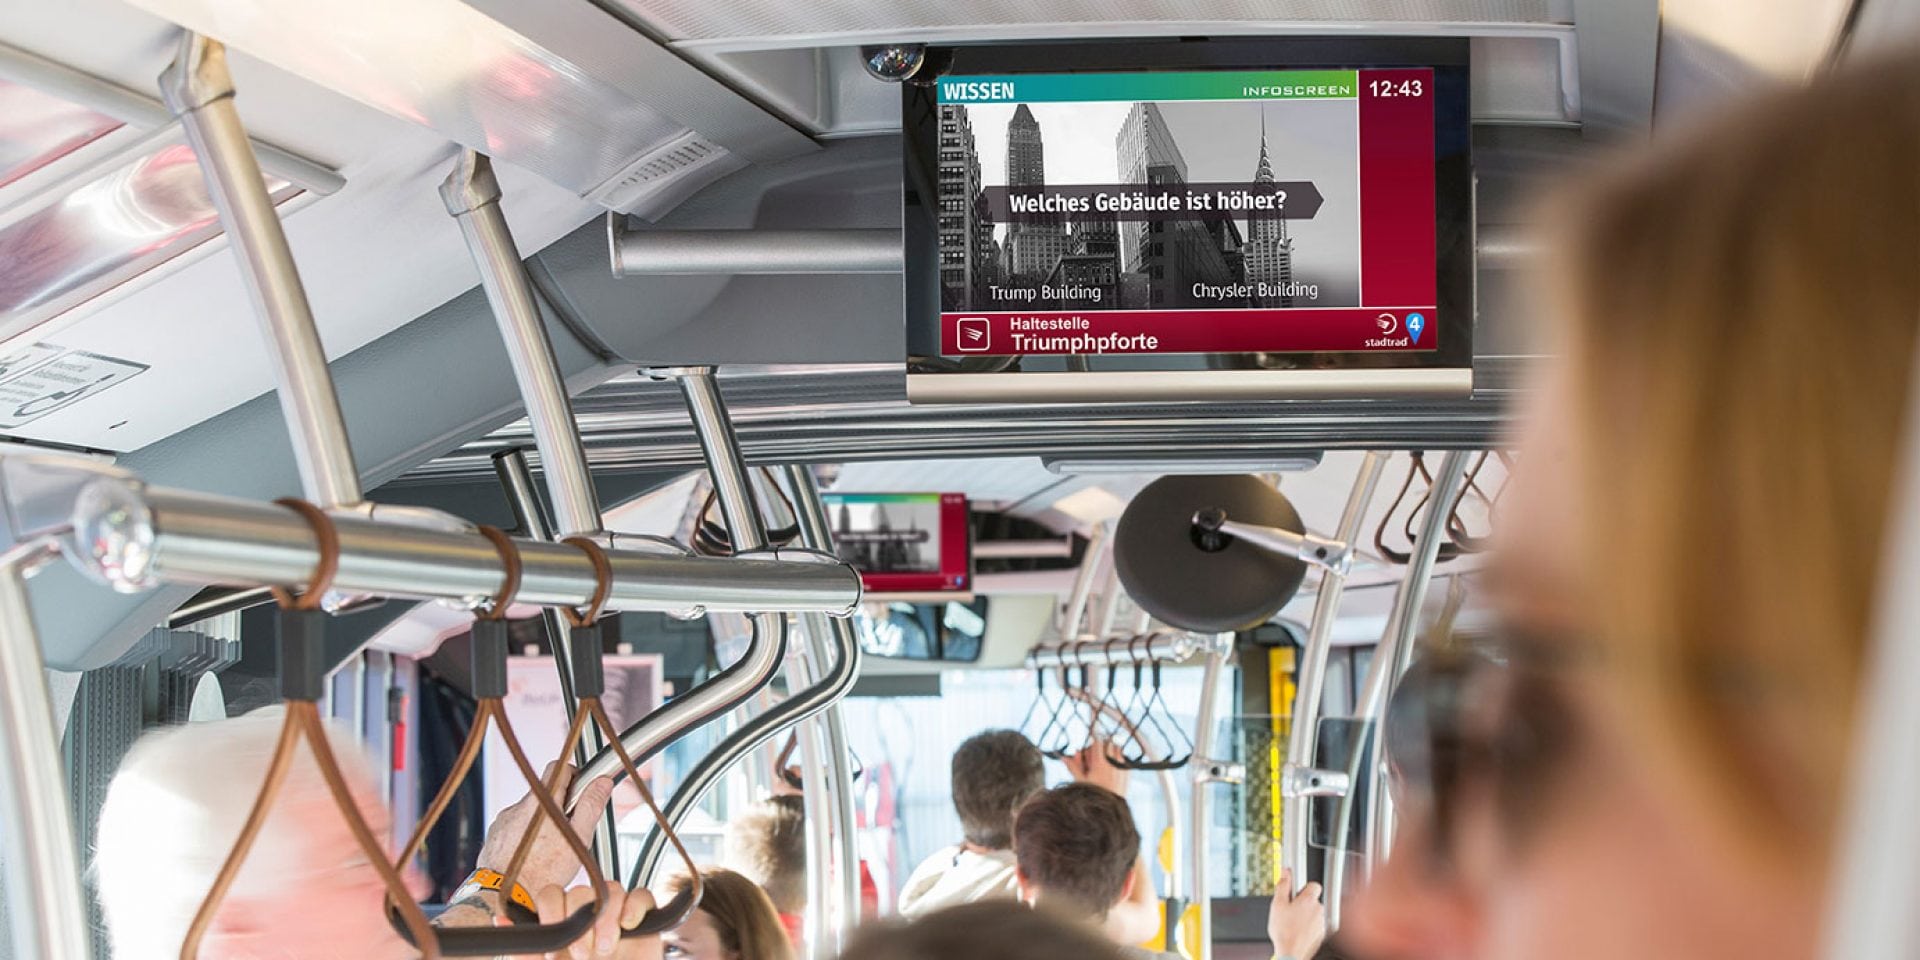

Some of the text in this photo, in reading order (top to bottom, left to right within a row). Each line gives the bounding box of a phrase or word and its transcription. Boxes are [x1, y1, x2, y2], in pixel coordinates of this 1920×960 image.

[944, 82, 1014, 100] WISSEN
[1243, 85, 1350, 97] INFOSCREEN
[1369, 80, 1423, 97] 12:43
[1009, 190, 1287, 212] Welches Gebäude ist höher?
[990, 284, 1101, 303] Trump Building
[1192, 281, 1318, 300] Chrysler Building
[1010, 316, 1090, 330] Haltestelle
[1409, 316, 1420, 332] 4
[1011, 332, 1158, 354] Triumphpforte
[1365, 337, 1409, 347] stadtrad
